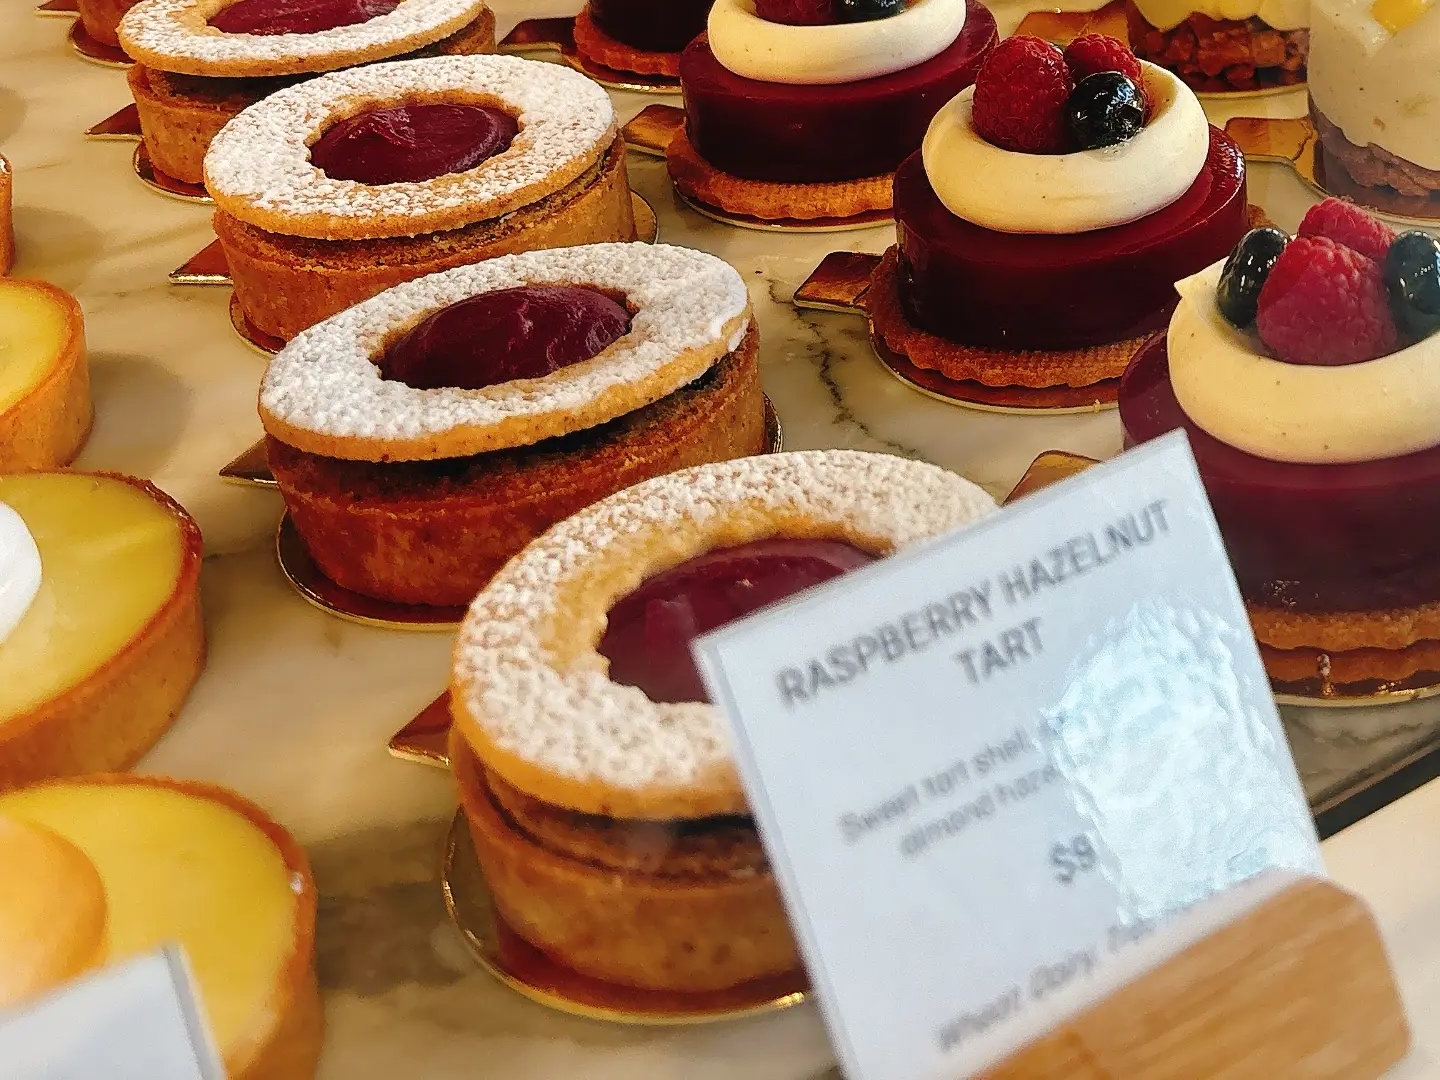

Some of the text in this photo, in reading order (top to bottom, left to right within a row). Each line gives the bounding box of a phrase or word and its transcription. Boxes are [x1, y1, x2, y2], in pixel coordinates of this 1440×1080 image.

[774, 500, 1172, 708] RASPBERRY HAZELNUT
[955, 617, 1045, 687] TART
[840, 783, 917, 845] Sweet
[922, 759, 969, 797] tart
[900, 792, 995, 860] almond
